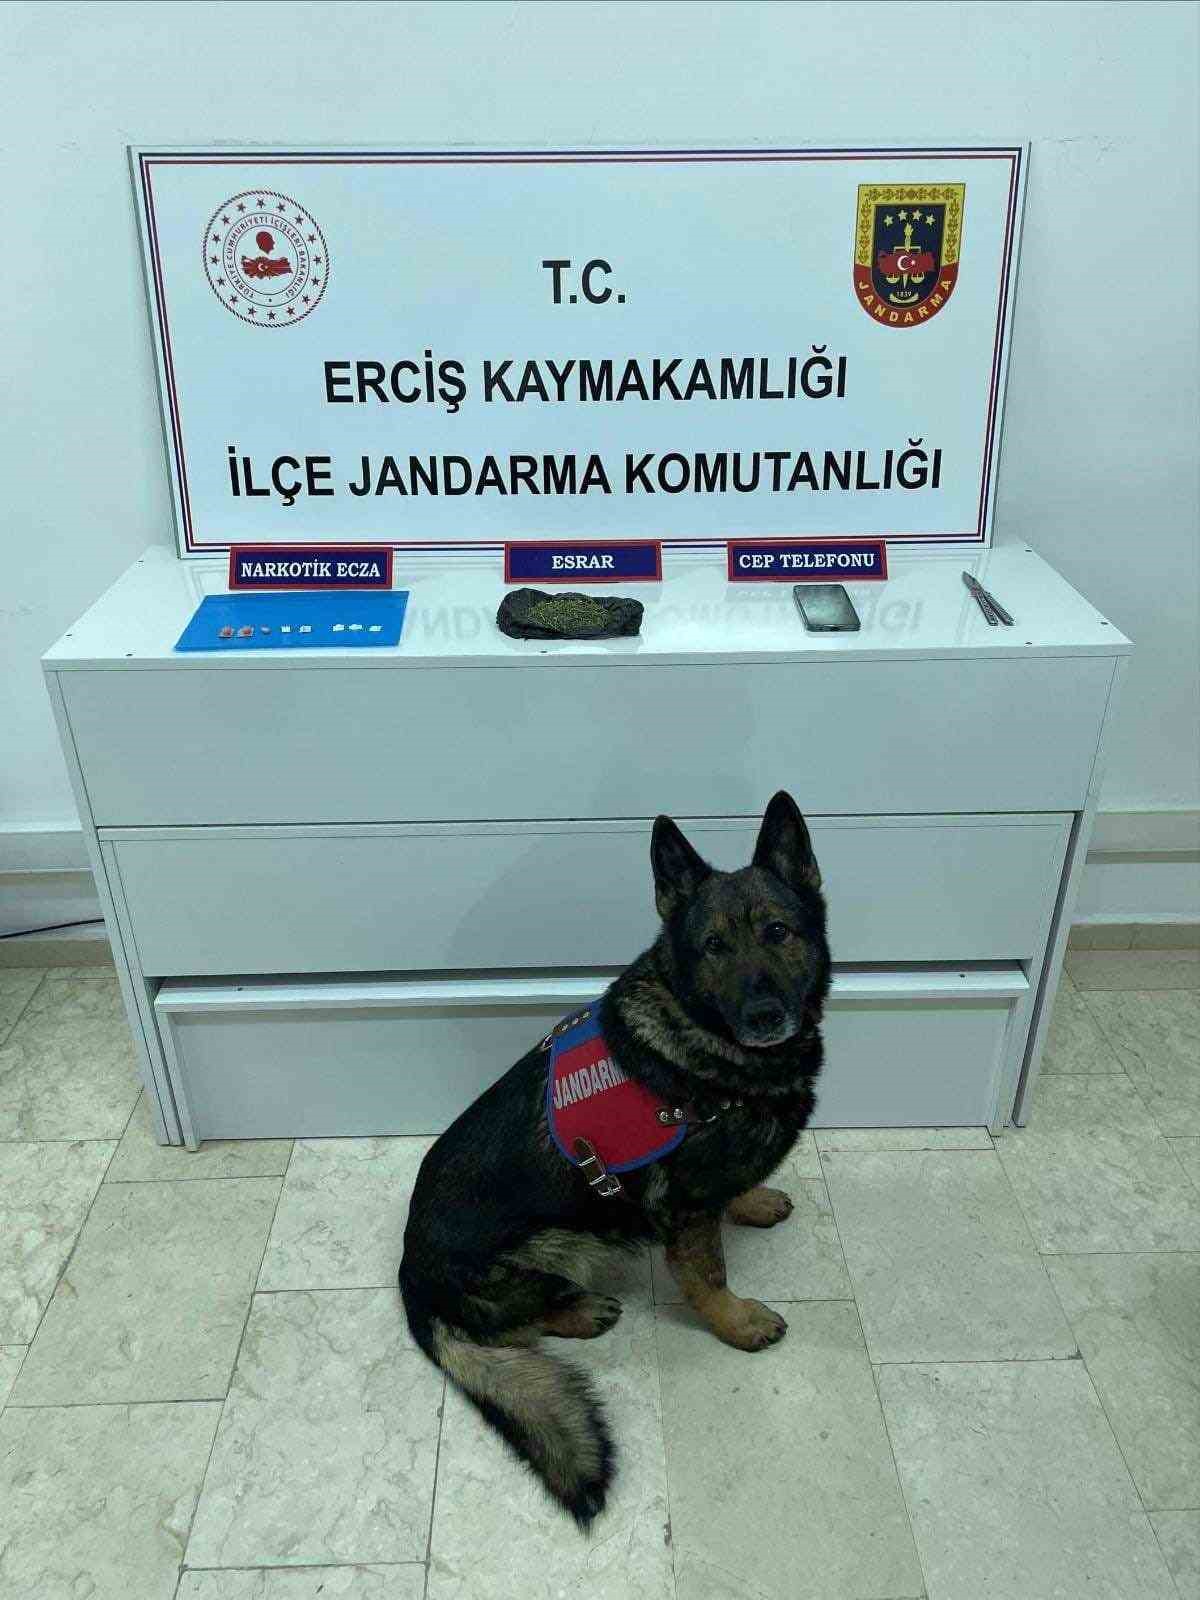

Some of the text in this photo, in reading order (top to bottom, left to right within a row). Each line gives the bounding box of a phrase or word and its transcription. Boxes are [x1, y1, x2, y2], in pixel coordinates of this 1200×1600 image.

[542, 259, 626, 305] T.C.
[858, 280, 952, 323] JANDARMA
[324, 345, 847, 414] ERCİŞ KAYMAKAMLIĞI
[228, 438, 942, 507] İLÇE JANDARMA KOMUTANLIĞI
[240, 558, 381, 579] NARKOTİK ECZA
[551, 554, 615, 570] ESRAR
[739, 553, 875, 569] CEP TELEFONU
[552, 1057, 626, 1110] JANDARM
